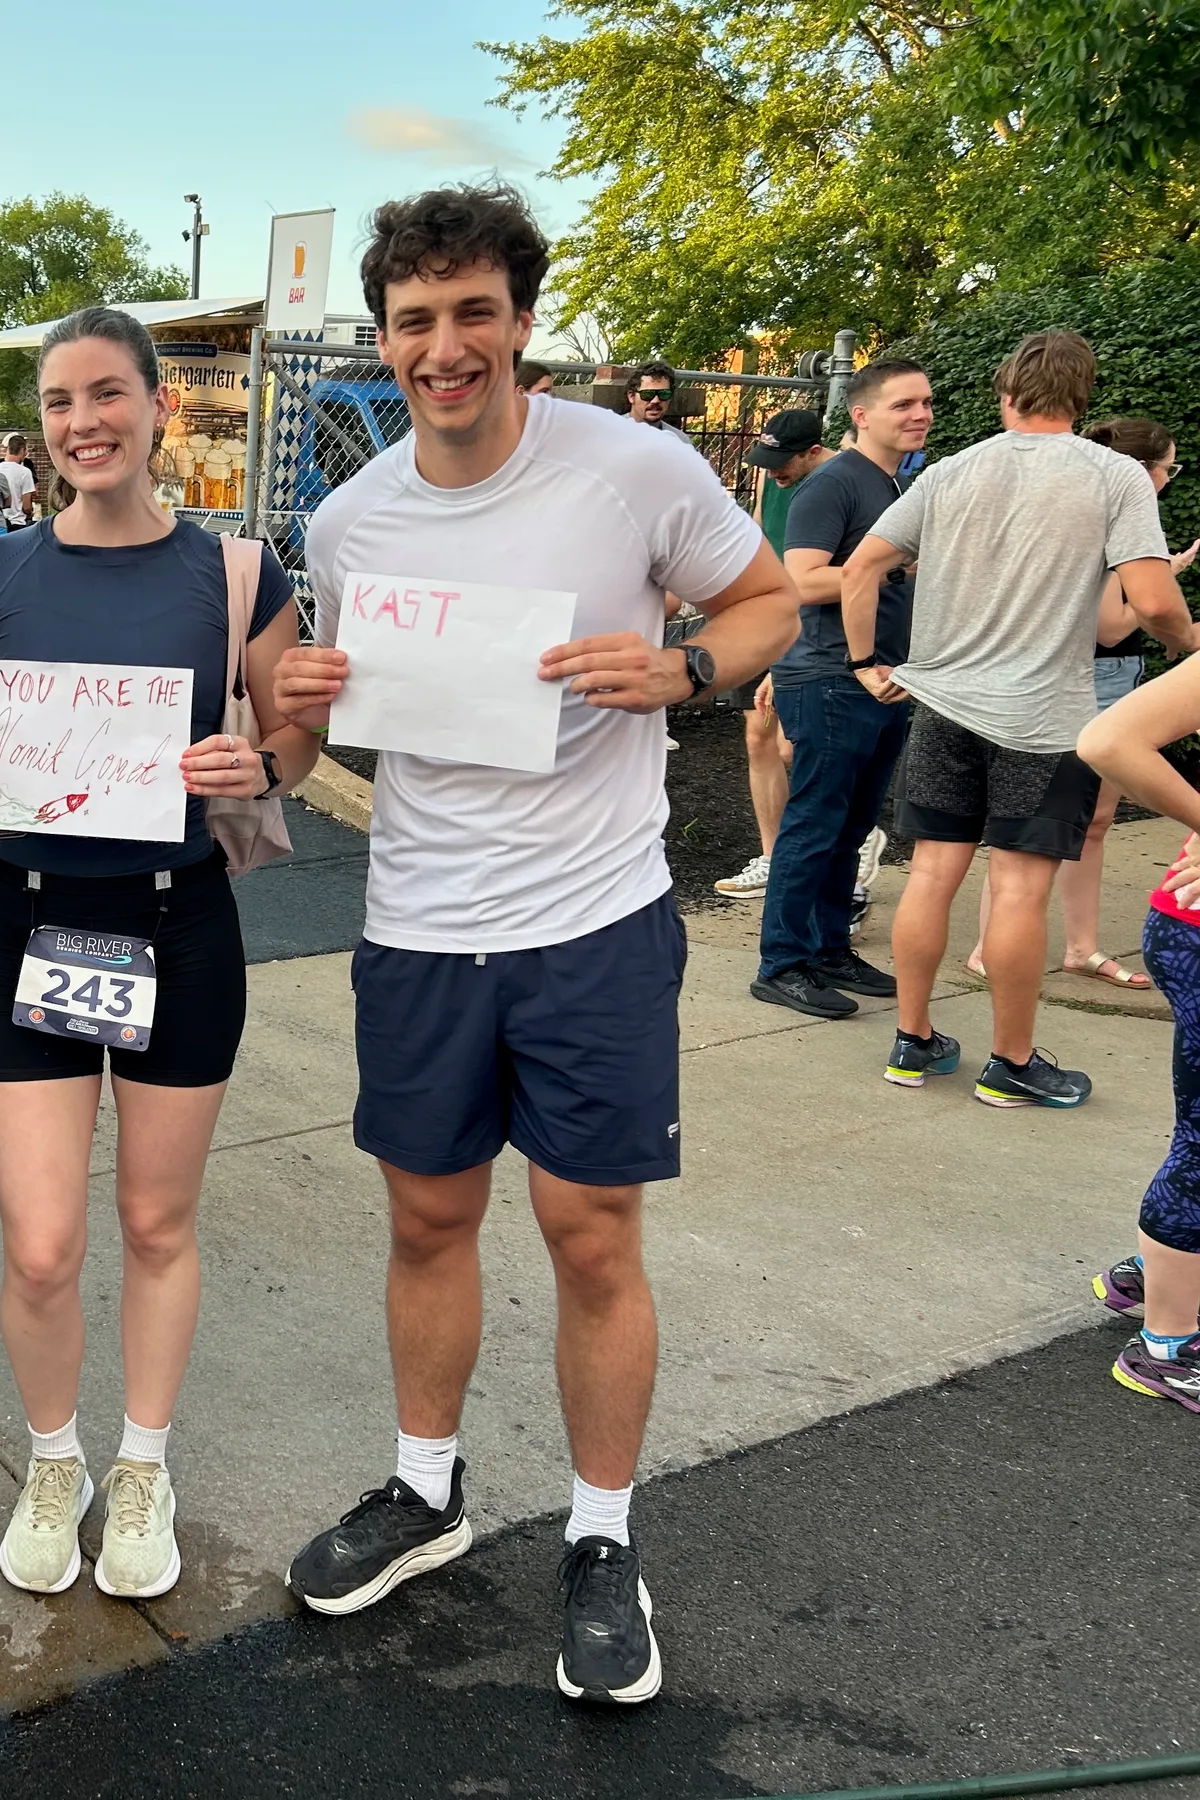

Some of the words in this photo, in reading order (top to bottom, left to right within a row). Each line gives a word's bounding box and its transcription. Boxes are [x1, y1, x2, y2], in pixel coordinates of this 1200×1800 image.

[288, 287, 306, 303] BAR
[352, 582, 461, 637] KAST
[0, 669, 55, 704] YOU
[72, 676, 134, 712] ARE
[147, 675, 184, 707] THE
[56, 933, 83, 949] BIG
[86, 937, 132, 956] RIVER
[41, 968, 135, 1018] 243
